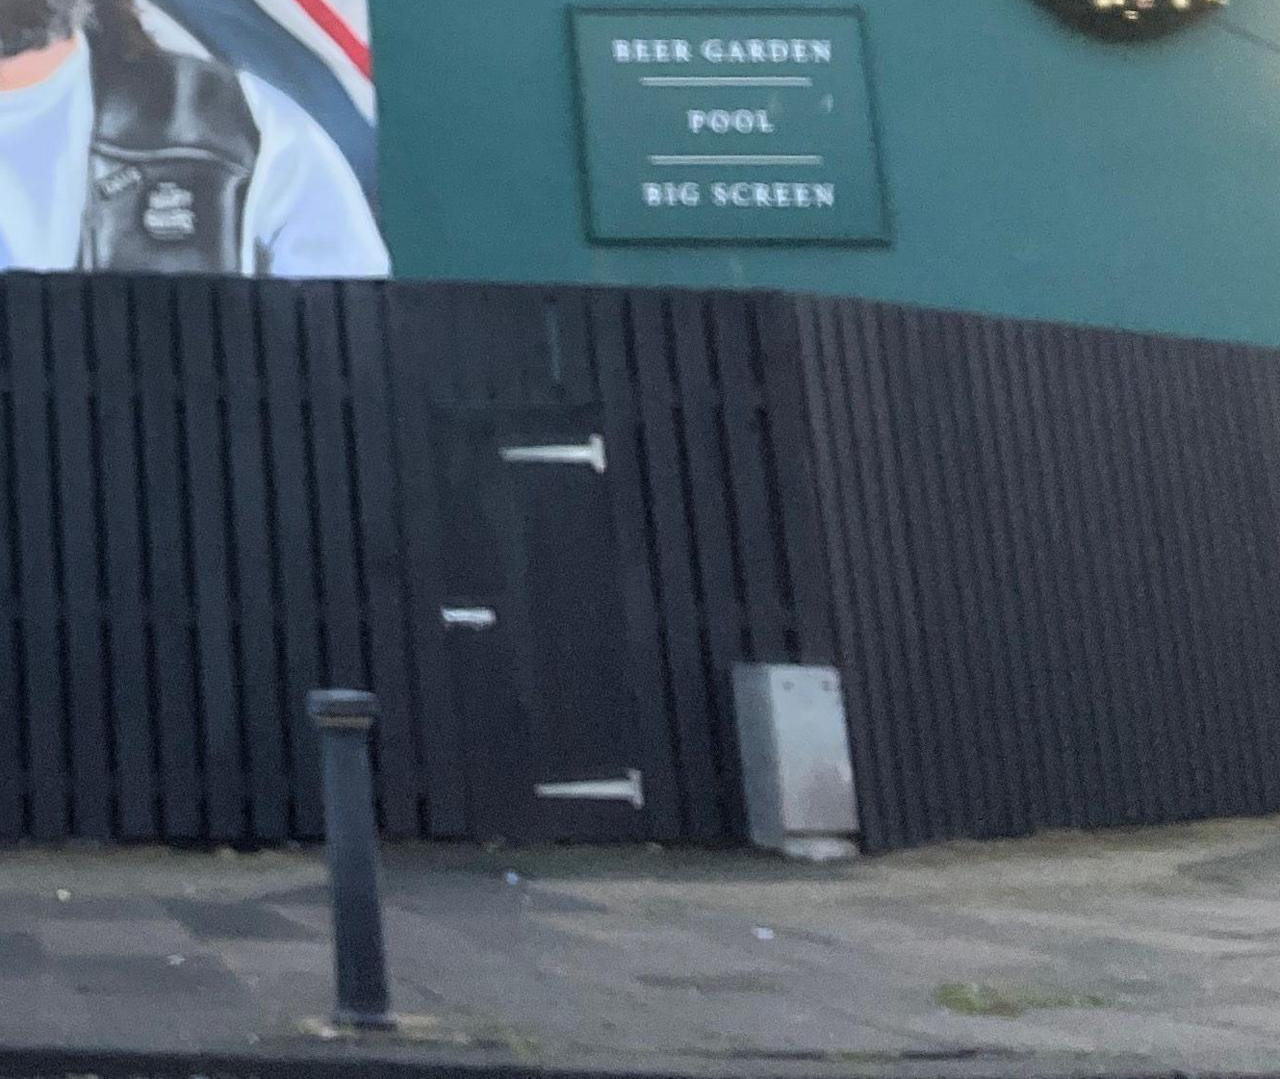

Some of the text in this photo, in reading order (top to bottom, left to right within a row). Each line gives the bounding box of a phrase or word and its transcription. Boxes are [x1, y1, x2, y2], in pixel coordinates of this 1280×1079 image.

[612, 39, 831, 63] BEER GARDEN
[687, 109, 773, 133] POOL
[642, 182, 834, 208] BIG SCREEN
